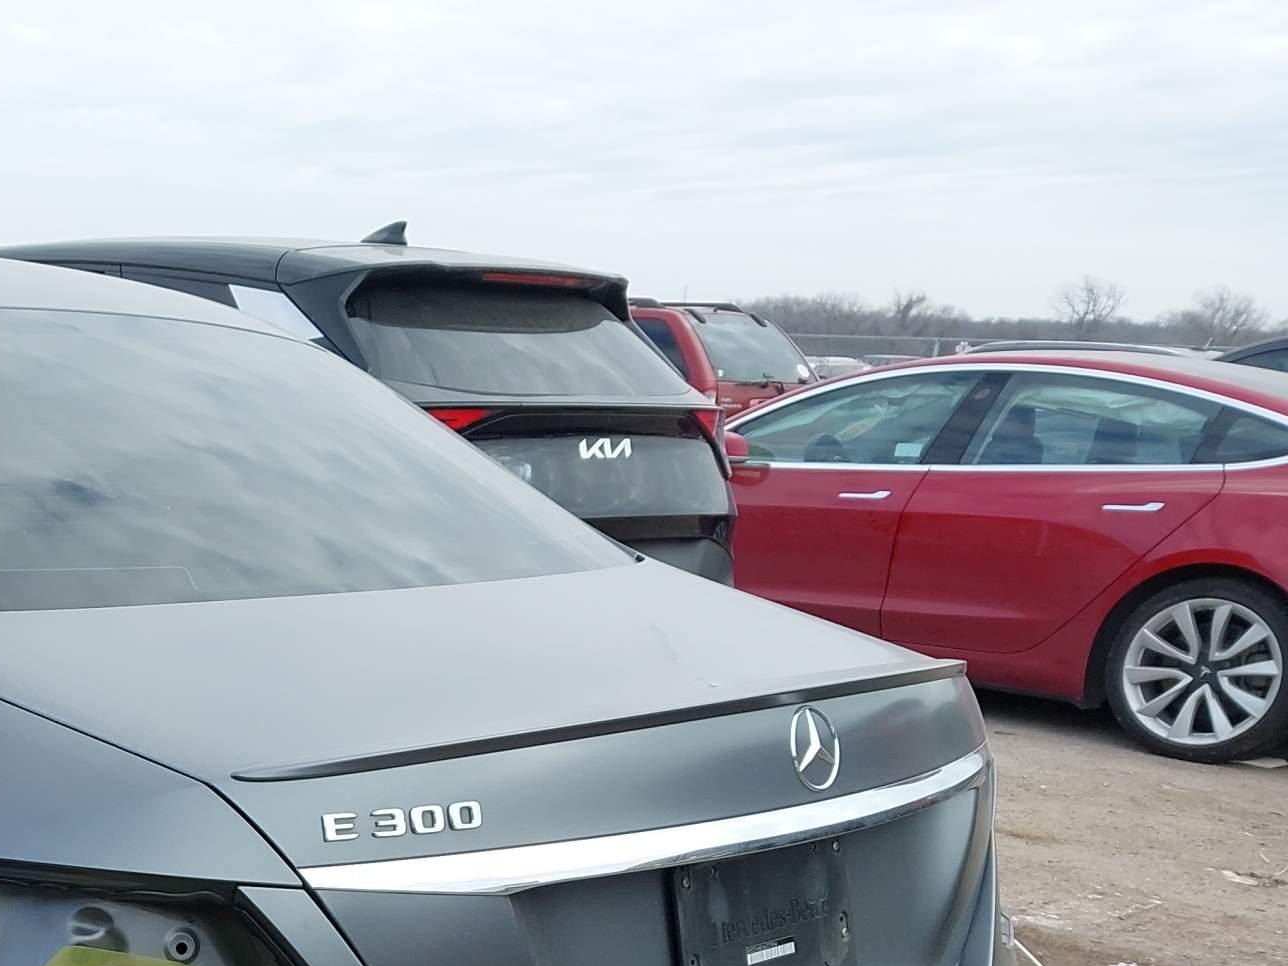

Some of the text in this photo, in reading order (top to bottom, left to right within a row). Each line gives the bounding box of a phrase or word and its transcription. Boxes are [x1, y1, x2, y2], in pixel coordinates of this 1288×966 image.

[579, 437, 632, 459] KIA
[321, 800, 482, 842] E 300
